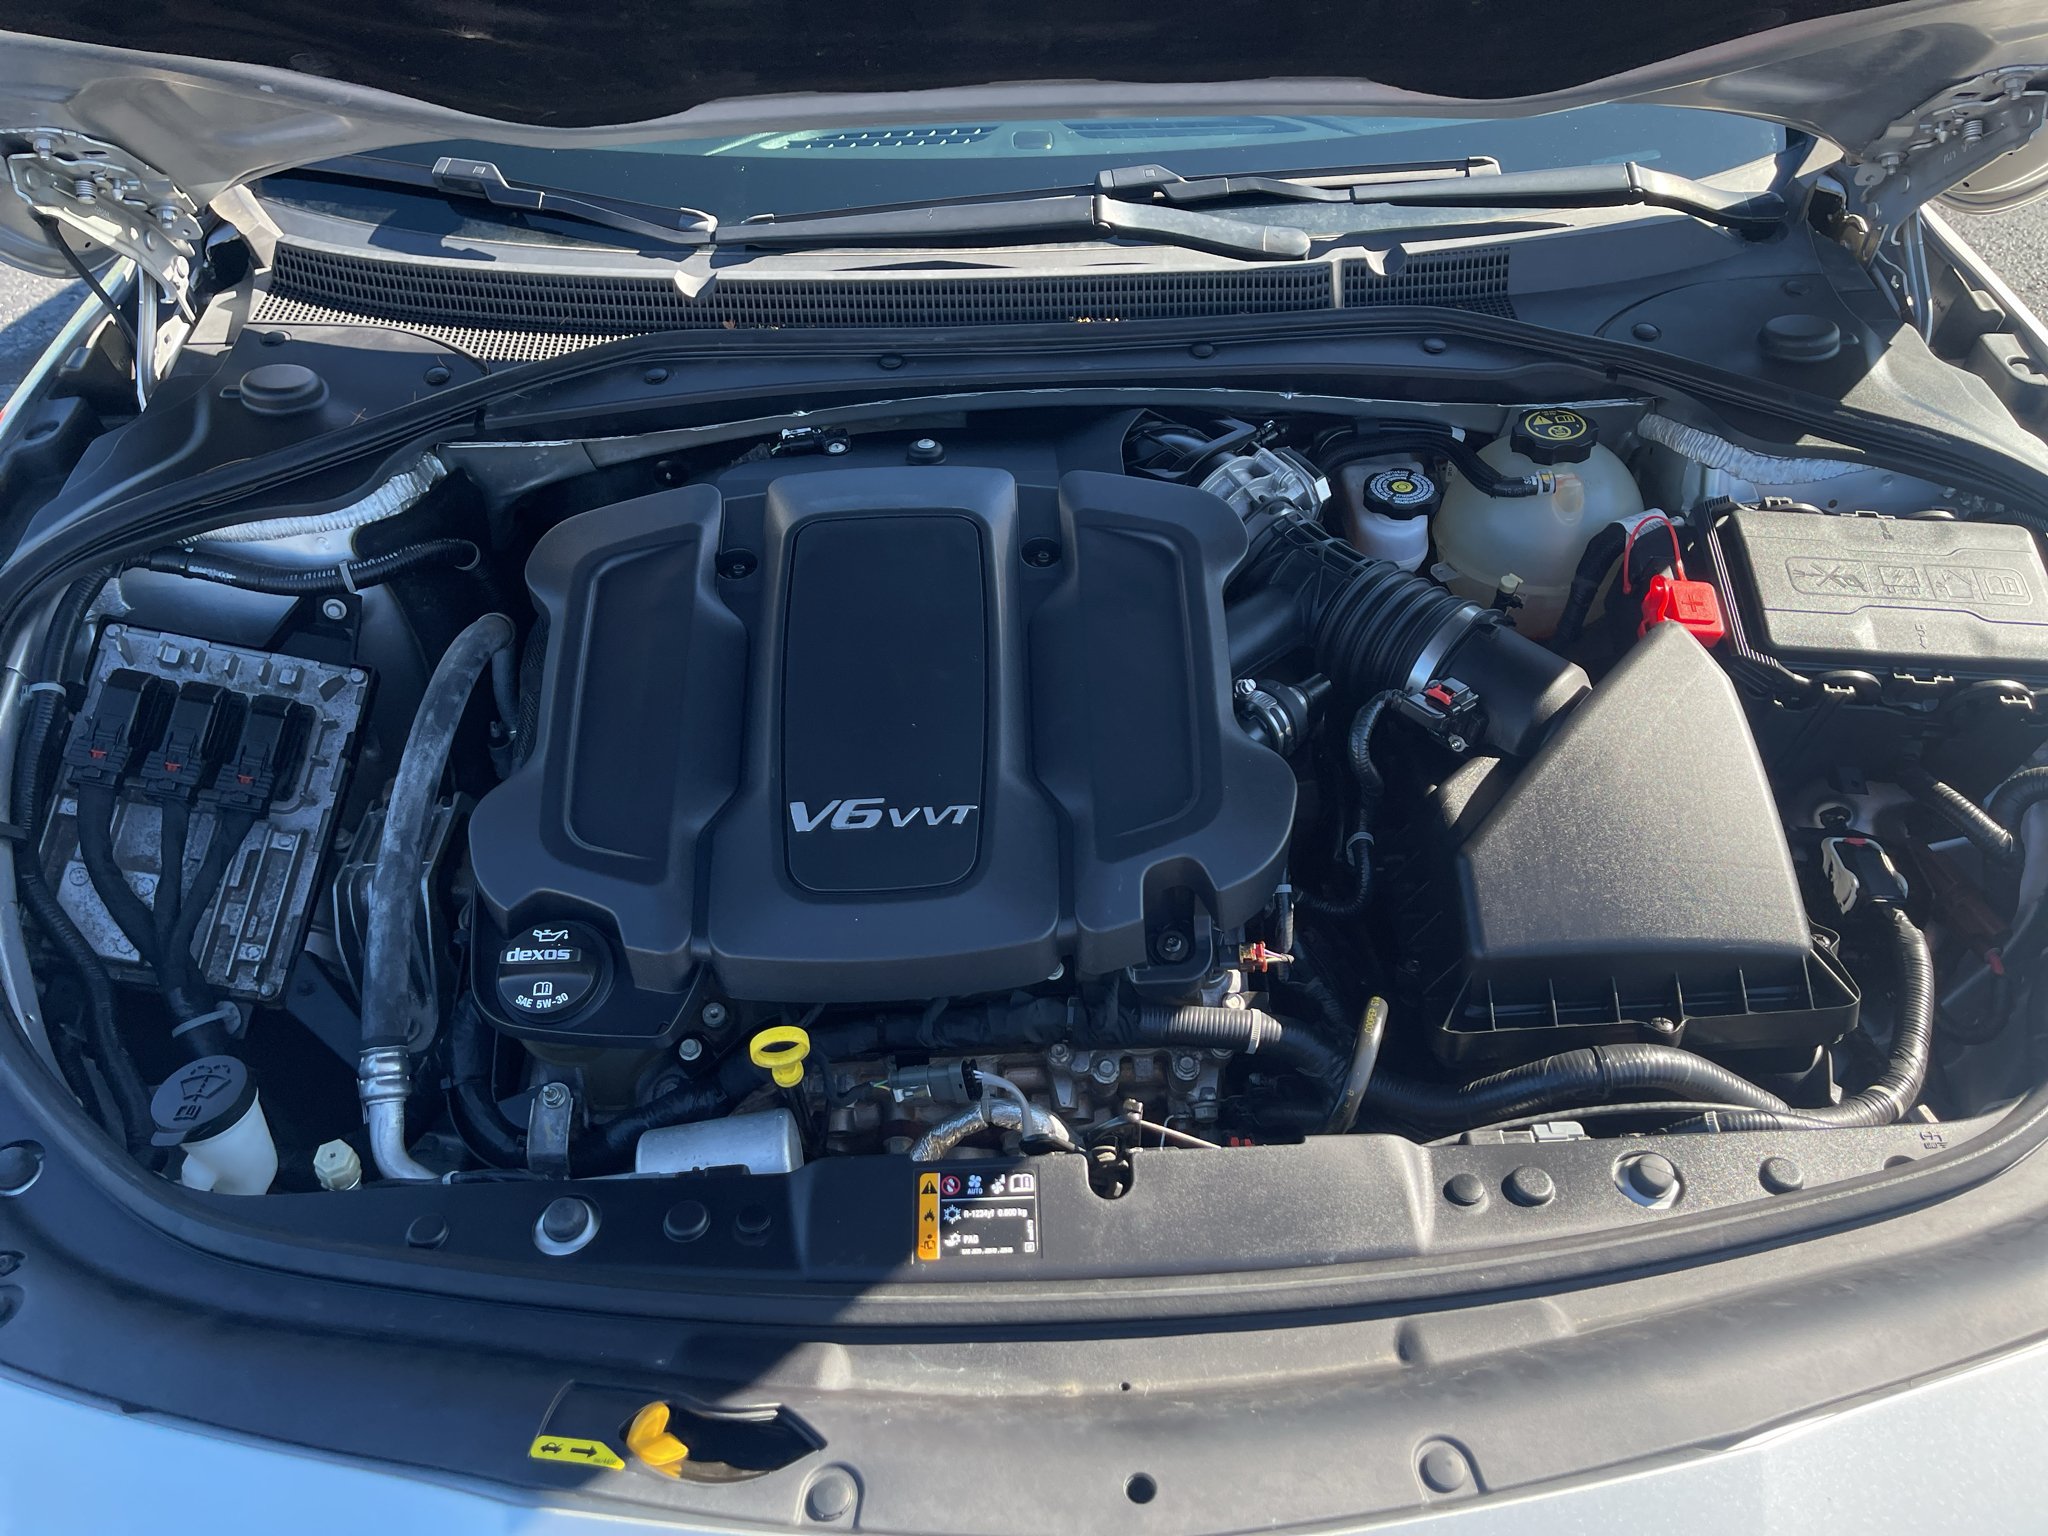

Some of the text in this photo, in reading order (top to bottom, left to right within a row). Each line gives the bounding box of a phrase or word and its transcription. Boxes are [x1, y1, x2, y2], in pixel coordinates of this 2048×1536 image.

[789, 798, 978, 832] V6 VVT
[506, 948, 573, 962] dexos
[516, 993, 569, 1009] SAE 5W-30
[967, 1187, 984, 1195] AUTO
